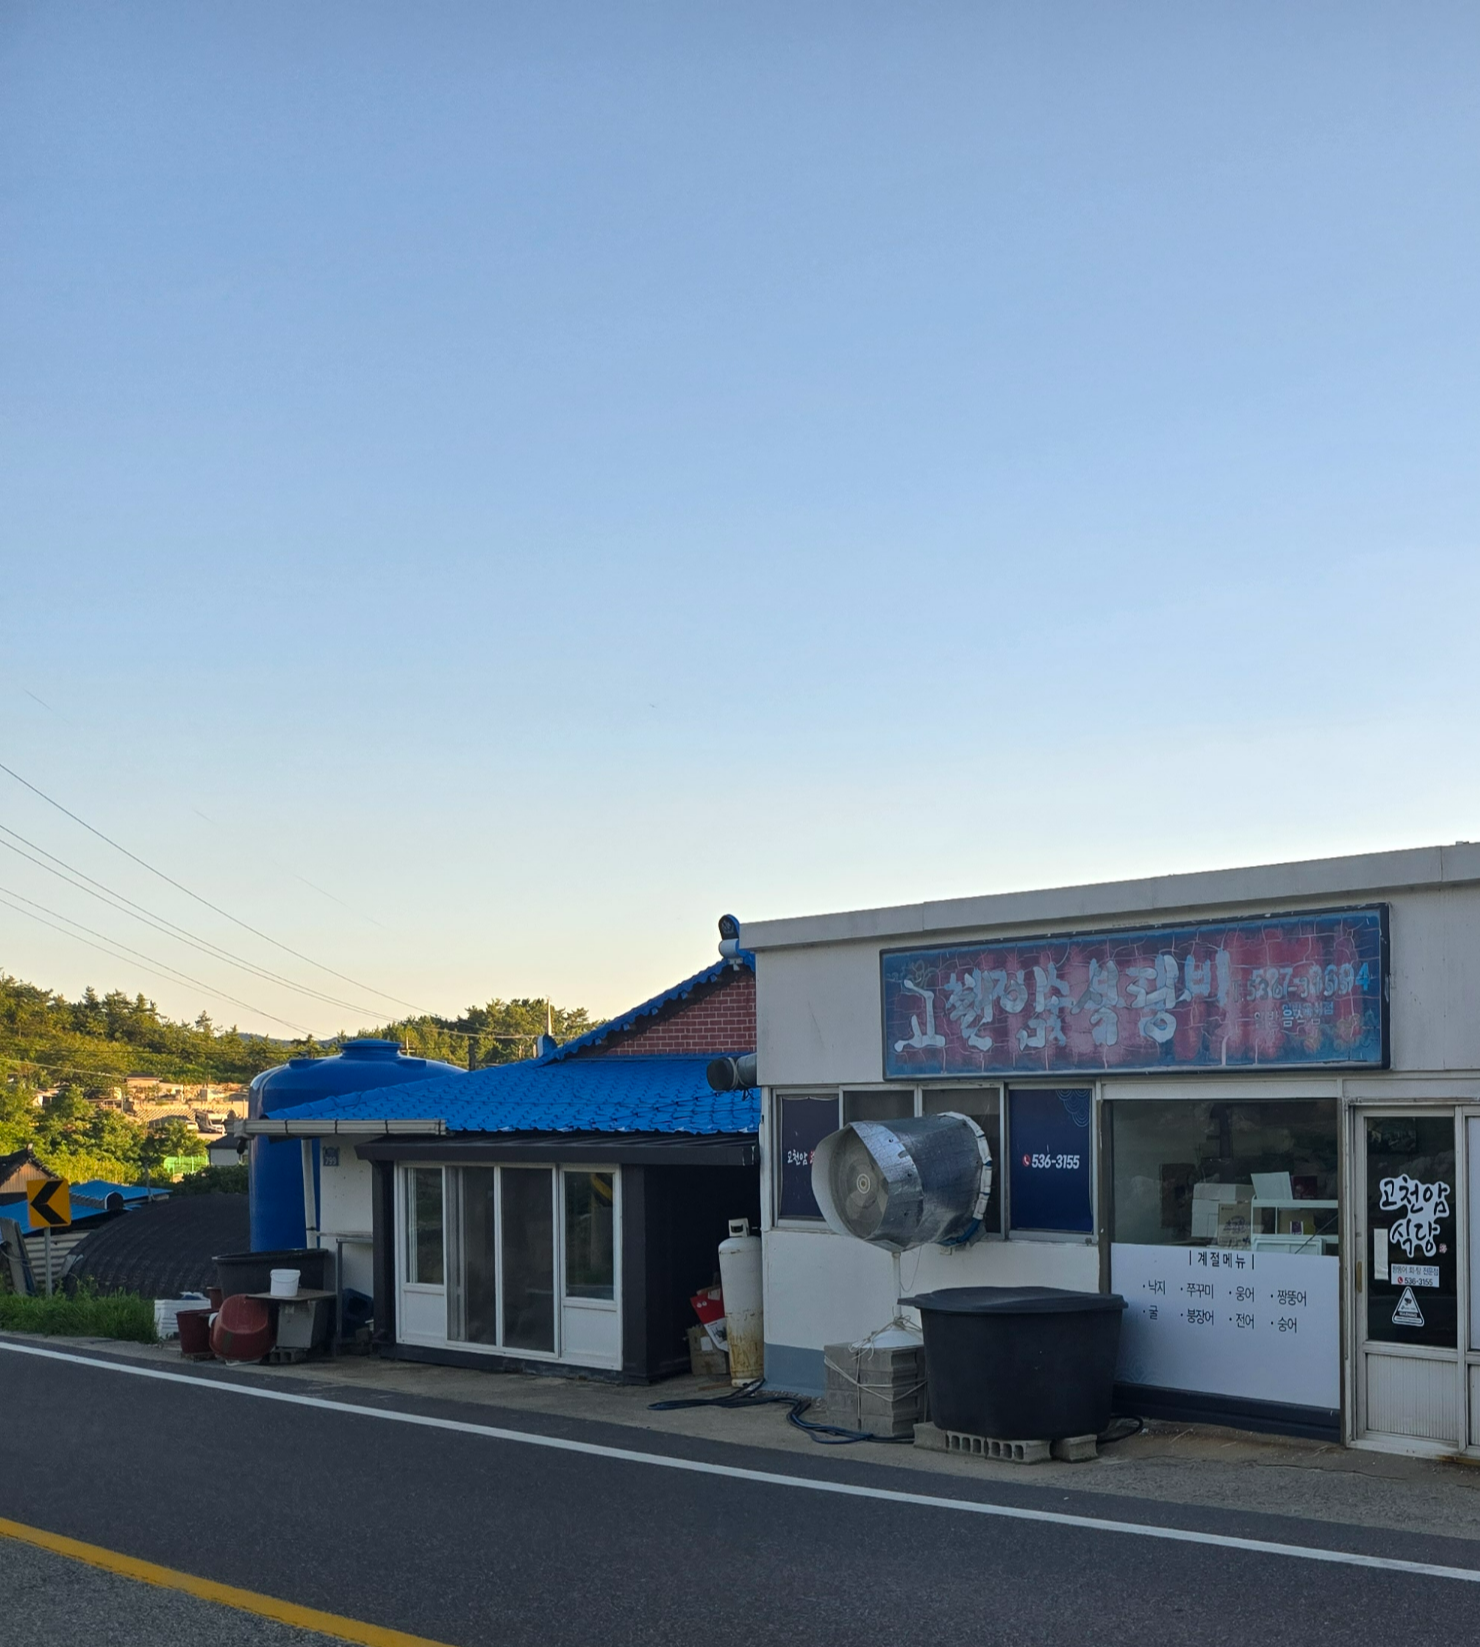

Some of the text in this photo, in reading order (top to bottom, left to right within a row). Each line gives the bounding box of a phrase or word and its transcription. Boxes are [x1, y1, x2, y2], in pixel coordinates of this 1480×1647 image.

[1031, 1153, 1080, 1170] 536-3155
[1381, 1176, 1449, 1216] 고천암
[1391, 1217, 1439, 1257] 식당
[1197, 1251, 1247, 1270] 계절메뉴
[1147, 1279, 1308, 1307] 낙지 쭈꾸미 웅어 짱뚱어
[1404, 1277, 1434, 1286] 536-3155
[1148, 1304, 1298, 1334] 굴 붕장어 전어 숭어
